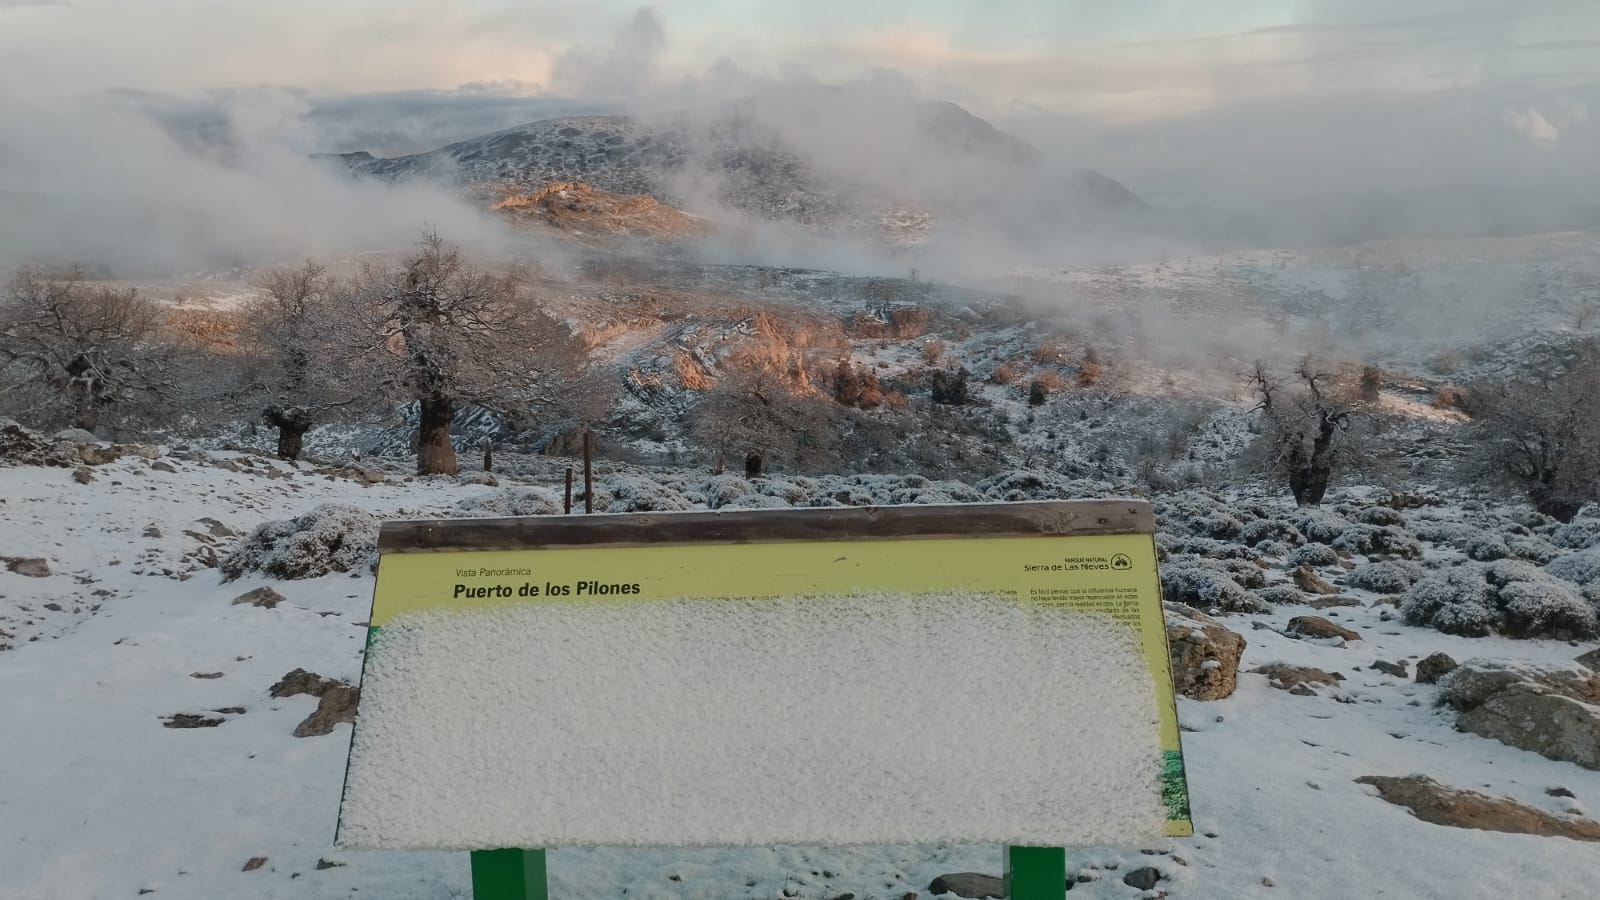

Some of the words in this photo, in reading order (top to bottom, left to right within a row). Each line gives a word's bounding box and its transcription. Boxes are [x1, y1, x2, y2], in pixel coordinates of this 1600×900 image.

[456, 568, 477, 577] Vista
[479, 567, 532, 577] Panorámica
[1064, 563, 1079, 571] Las
[453, 584, 513, 599] Puerto
[518, 583, 540, 597] de
[545, 582, 571, 596] los
[576, 580, 641, 596] Pilones
